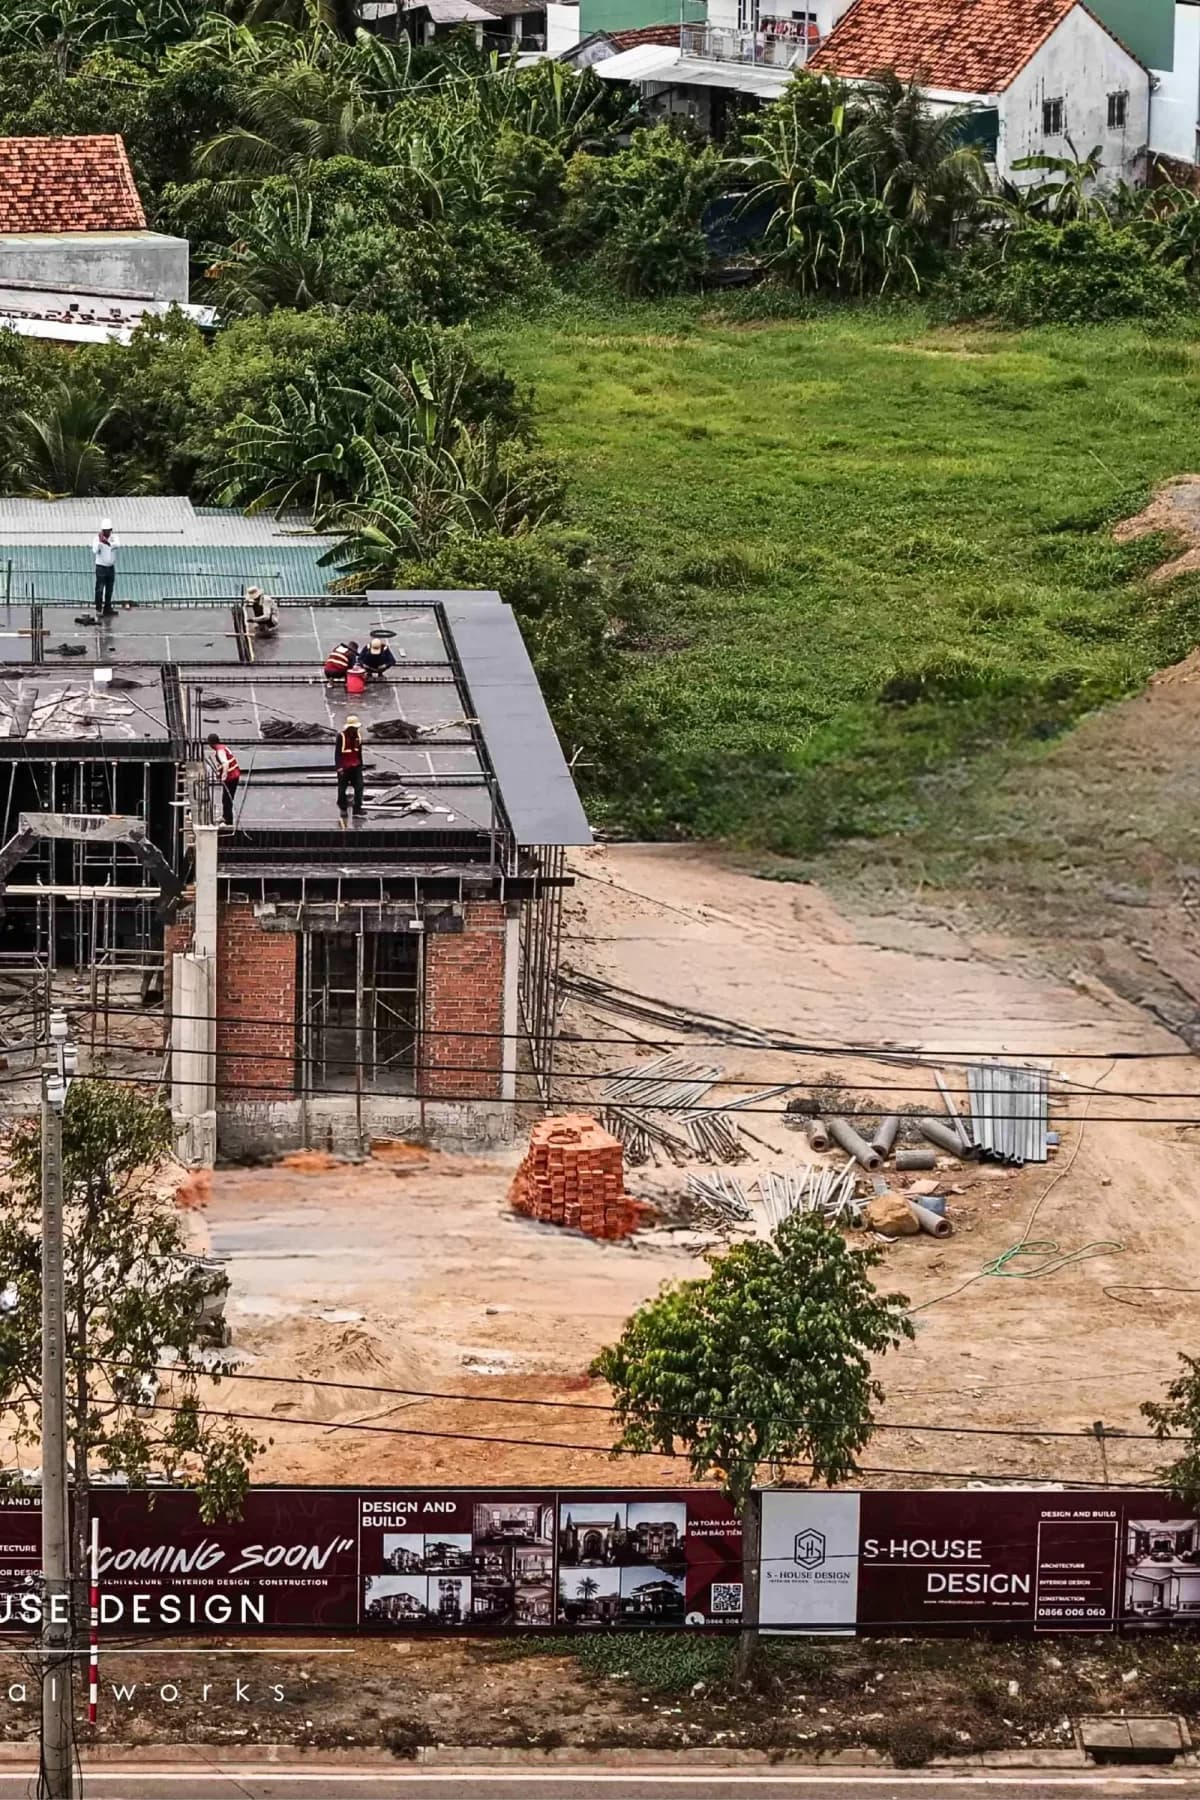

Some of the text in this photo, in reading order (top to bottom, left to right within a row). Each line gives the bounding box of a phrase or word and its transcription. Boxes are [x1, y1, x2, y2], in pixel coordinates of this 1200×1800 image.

[8, 1498, 31, 1506] AND
[362, 1502, 457, 1513] DESIGN AND
[362, 1516, 407, 1527] BUILD
[864, 1539, 983, 1558] S-HOUSE
[927, 1573, 1030, 1593] DESIGN
[1064, 1608, 1084, 1616] 006
[1086, 1608, 1106, 1616] 060
